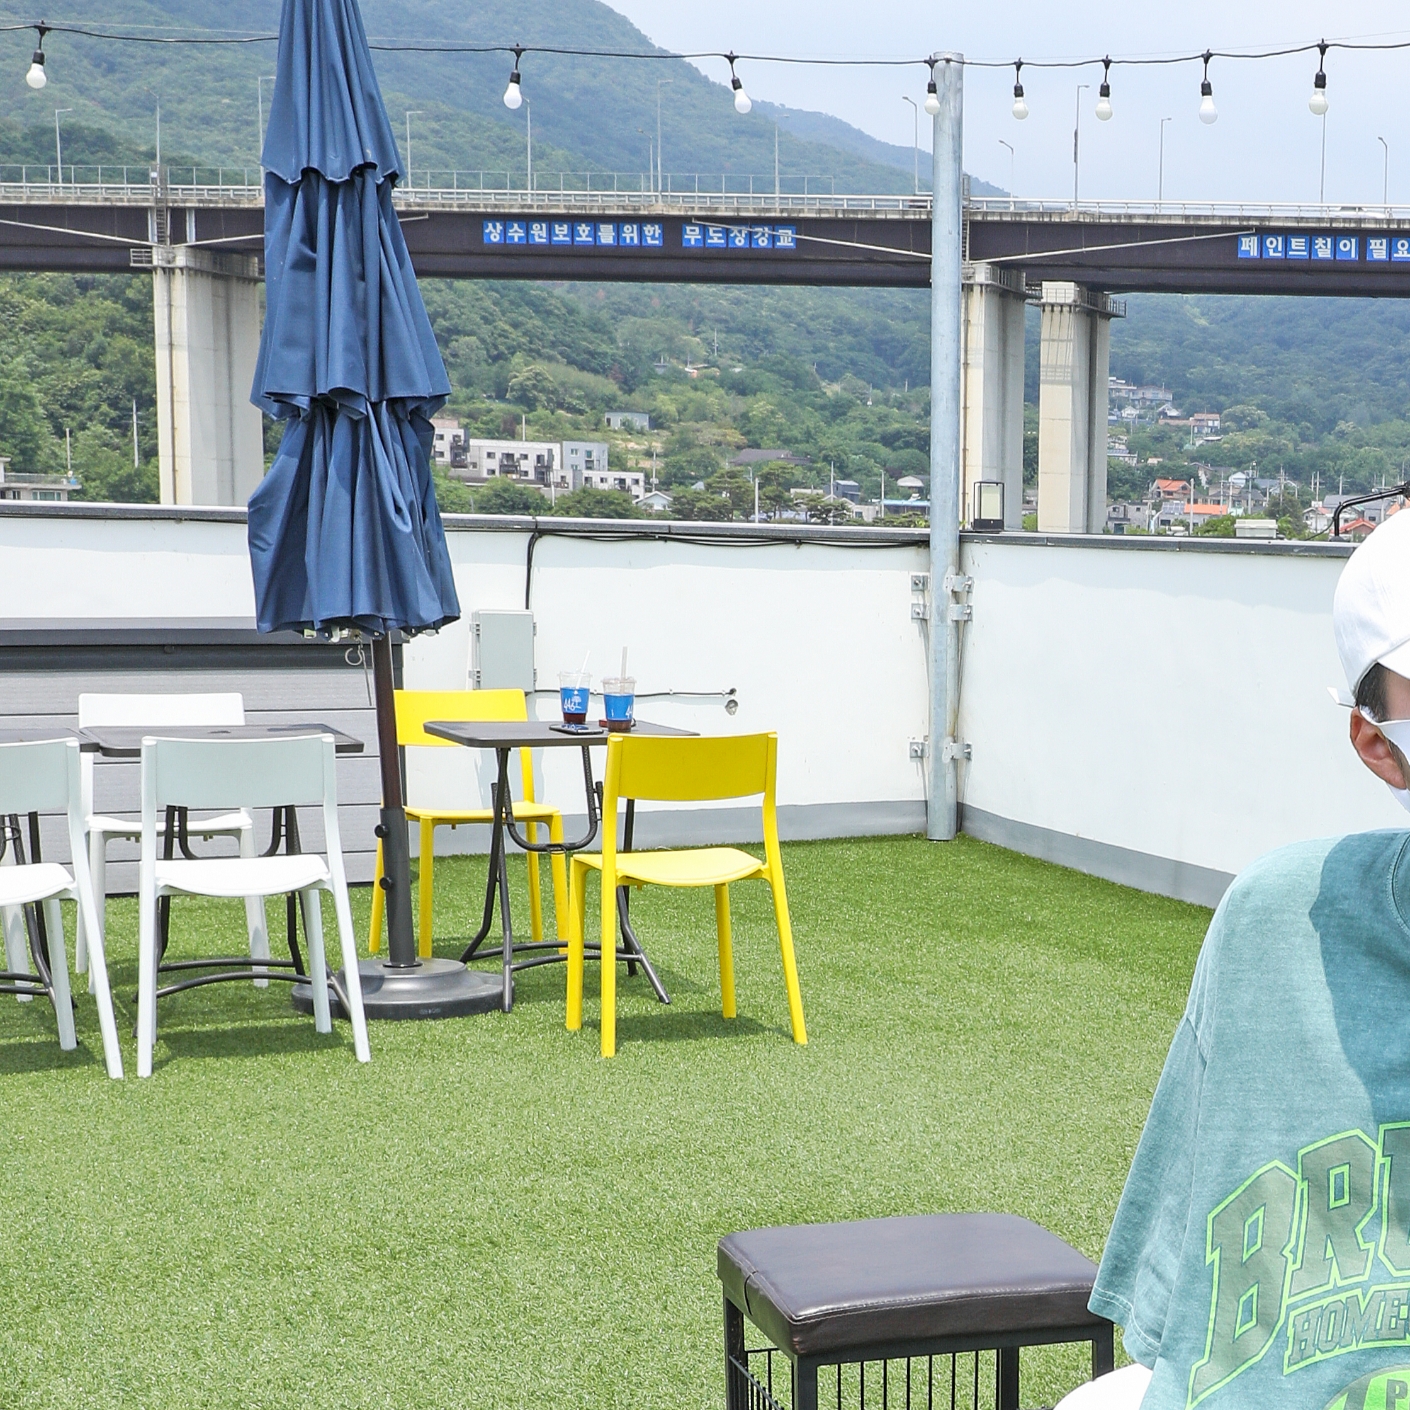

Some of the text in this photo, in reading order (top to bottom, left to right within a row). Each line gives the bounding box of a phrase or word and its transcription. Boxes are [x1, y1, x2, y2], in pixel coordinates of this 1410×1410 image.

[484, 221, 795, 247] 상수원보호를위한 무도장강교
[1240, 236, 1357, 259] 페인트칠이
